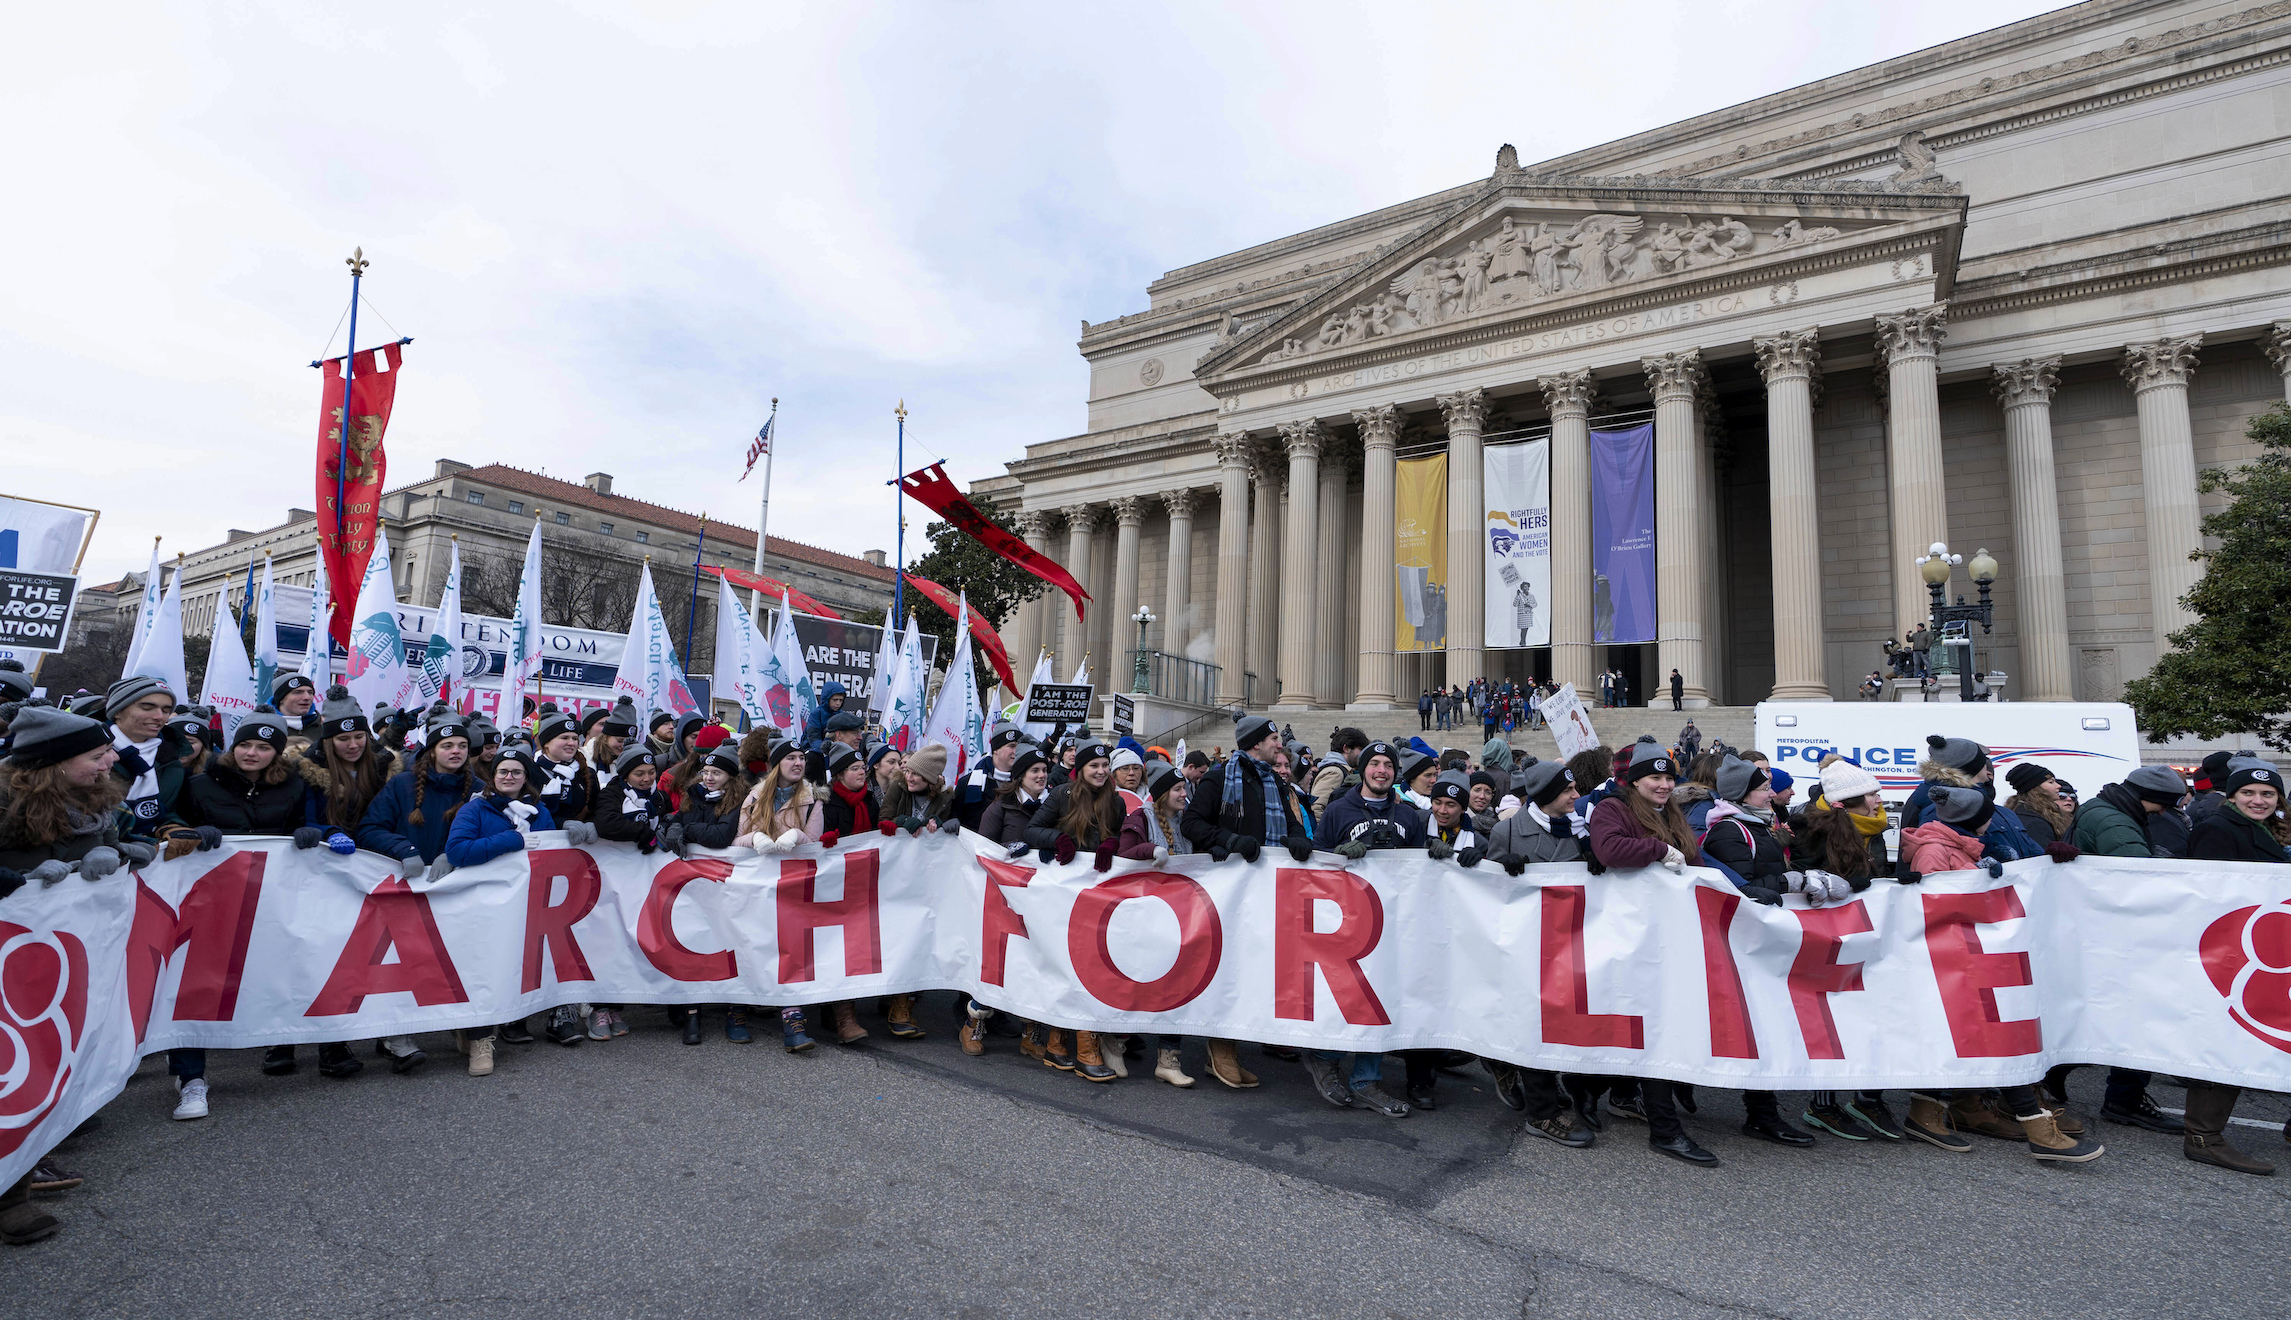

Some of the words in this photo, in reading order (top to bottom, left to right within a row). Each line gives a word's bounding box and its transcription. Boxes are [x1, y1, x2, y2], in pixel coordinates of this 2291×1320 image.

[1322, 364, 1400, 392] ARCHIVES
[1404, 358, 1426, 375] OF
[1432, 351, 1463, 370] THE
[1467, 337, 1534, 363] UNITED
[1541, 322, 1606, 349] STATES
[1612, 316, 1638, 334] OF
[1642, 294, 1747, 329] AMERICA
[1510, 507, 1548, 519] RIGHTFULLY
[1520, 514, 1548, 530] HERS
[1522, 531, 1548, 540] AMERICAN
[1621, 536, 1647, 544] Lawrence
[1519, 539, 1548, 550] WOMEN
[1525, 550, 1535, 558] THE
[1536, 548, 1548, 556] VOTE
[8, 584, 61, 601] THE
[805, 644, 840, 666] ARE
[842, 648, 871, 669] THE
[549, 663, 583, 680] LIFE
[1034, 690, 1039, 698] I
[1042, 690, 1062, 698] AM
[1065, 691, 1087, 699] THE
[1030, 698, 1088, 708] POST-ROE
[1030, 708, 1085, 718] GENERATION
[126, 847, 883, 1045] MARCH
[976, 854, 1391, 1026] FOR
[1540, 884, 2042, 1060] LIFE
